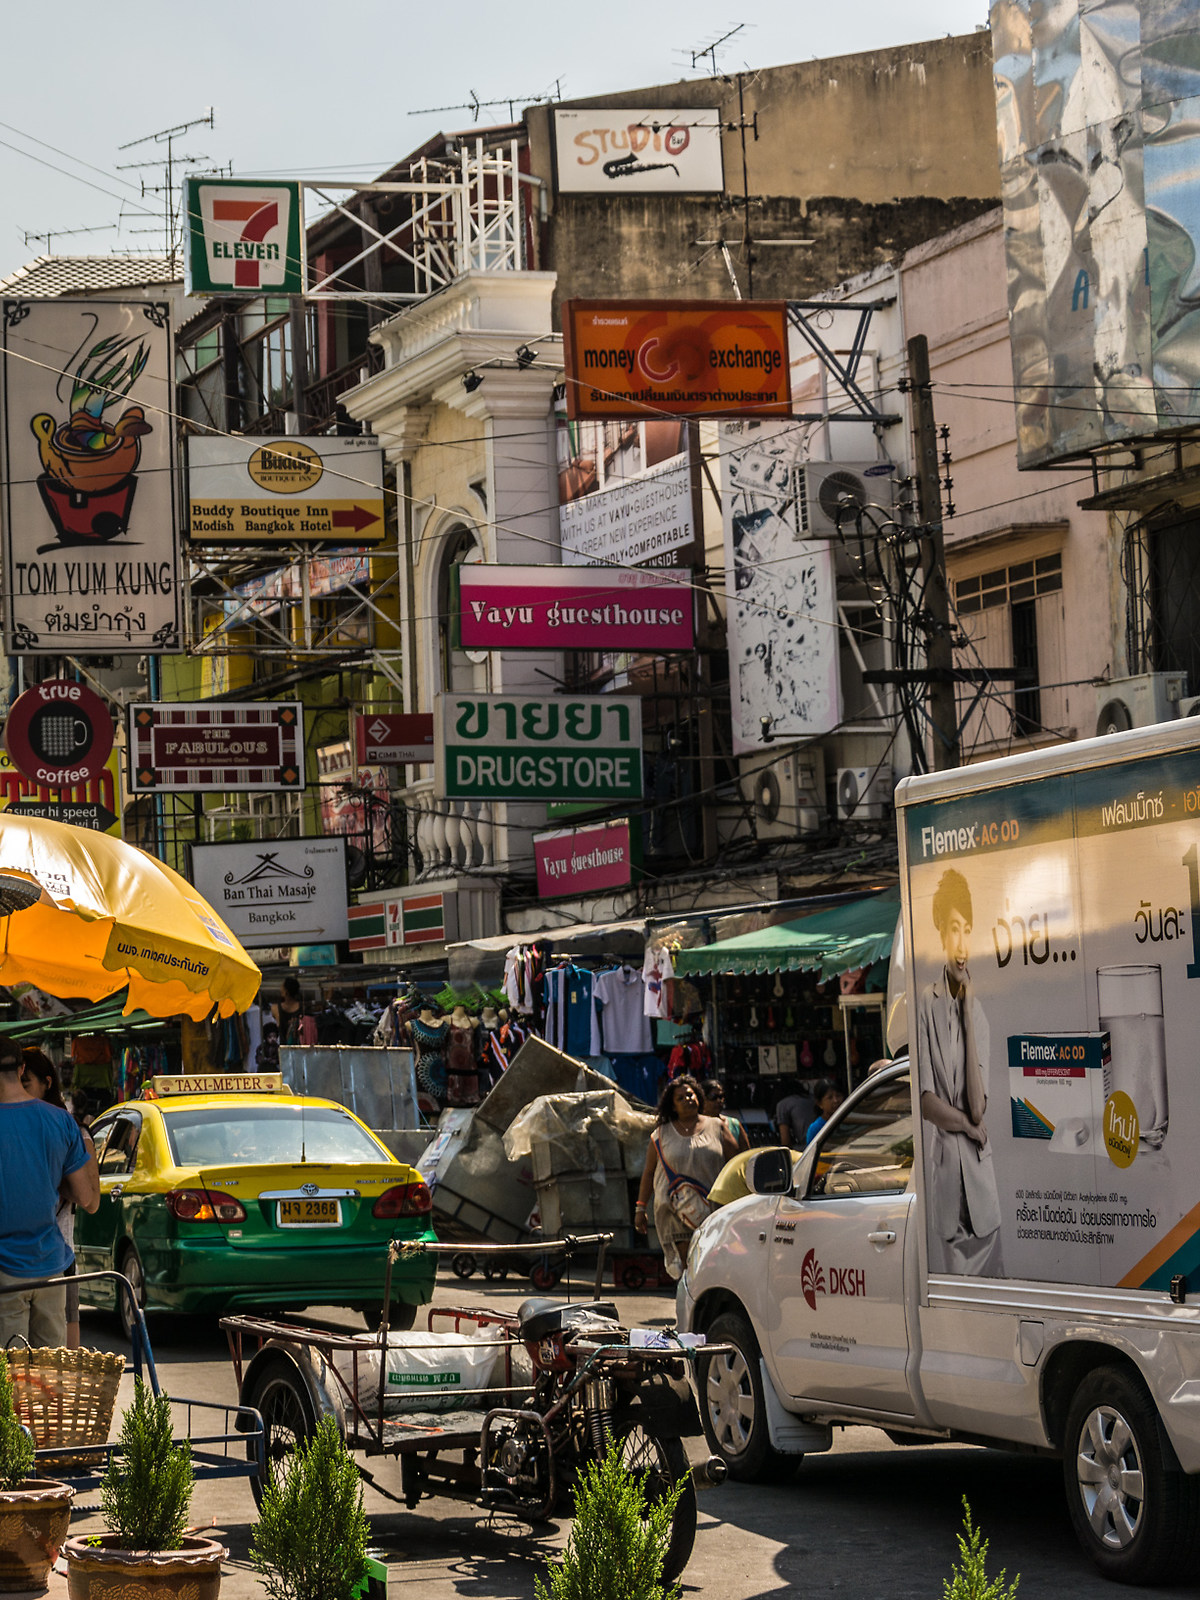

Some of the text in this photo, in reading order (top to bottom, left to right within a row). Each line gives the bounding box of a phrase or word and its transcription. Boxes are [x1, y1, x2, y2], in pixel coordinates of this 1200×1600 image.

[584, 344, 782, 374] money exchange
[261, 450, 311, 474] Buddy
[192, 505, 329, 519] Buddy Boutique Inn
[192, 520, 332, 534] Modish Bangkok Hotel
[15, 562, 172, 596] TOM YUM KUNG
[44, 603, 146, 642] ต้มยำกุ้ง
[470, 600, 684, 628] Vayu guesthouse
[39, 685, 81, 700] true
[456, 701, 630, 741] ขายยา
[202, 730, 231, 739] THE
[165, 742, 268, 754] FABULOUS
[37, 767, 89, 783] coffee
[456, 755, 631, 788] DRUGSTORE
[48, 806, 59, 817] hi
[63, 806, 97, 819] speed
[1001, 820, 1019, 842] OD
[543, 846, 623, 879] Vayu guesthouse
[224, 882, 316, 900] Ban Thai Masaje
[249, 911, 296, 924] Bangkok
[1135, 900, 1186, 943] วันละ
[1072, 1046, 1085, 1059] OD
[176, 1077, 262, 1092] TAXI-METER
[1109, 1101, 1136, 1144] ใหม่!
[306, 1202, 336, 1215] 2368
[830, 1268, 866, 1296] DKSH
